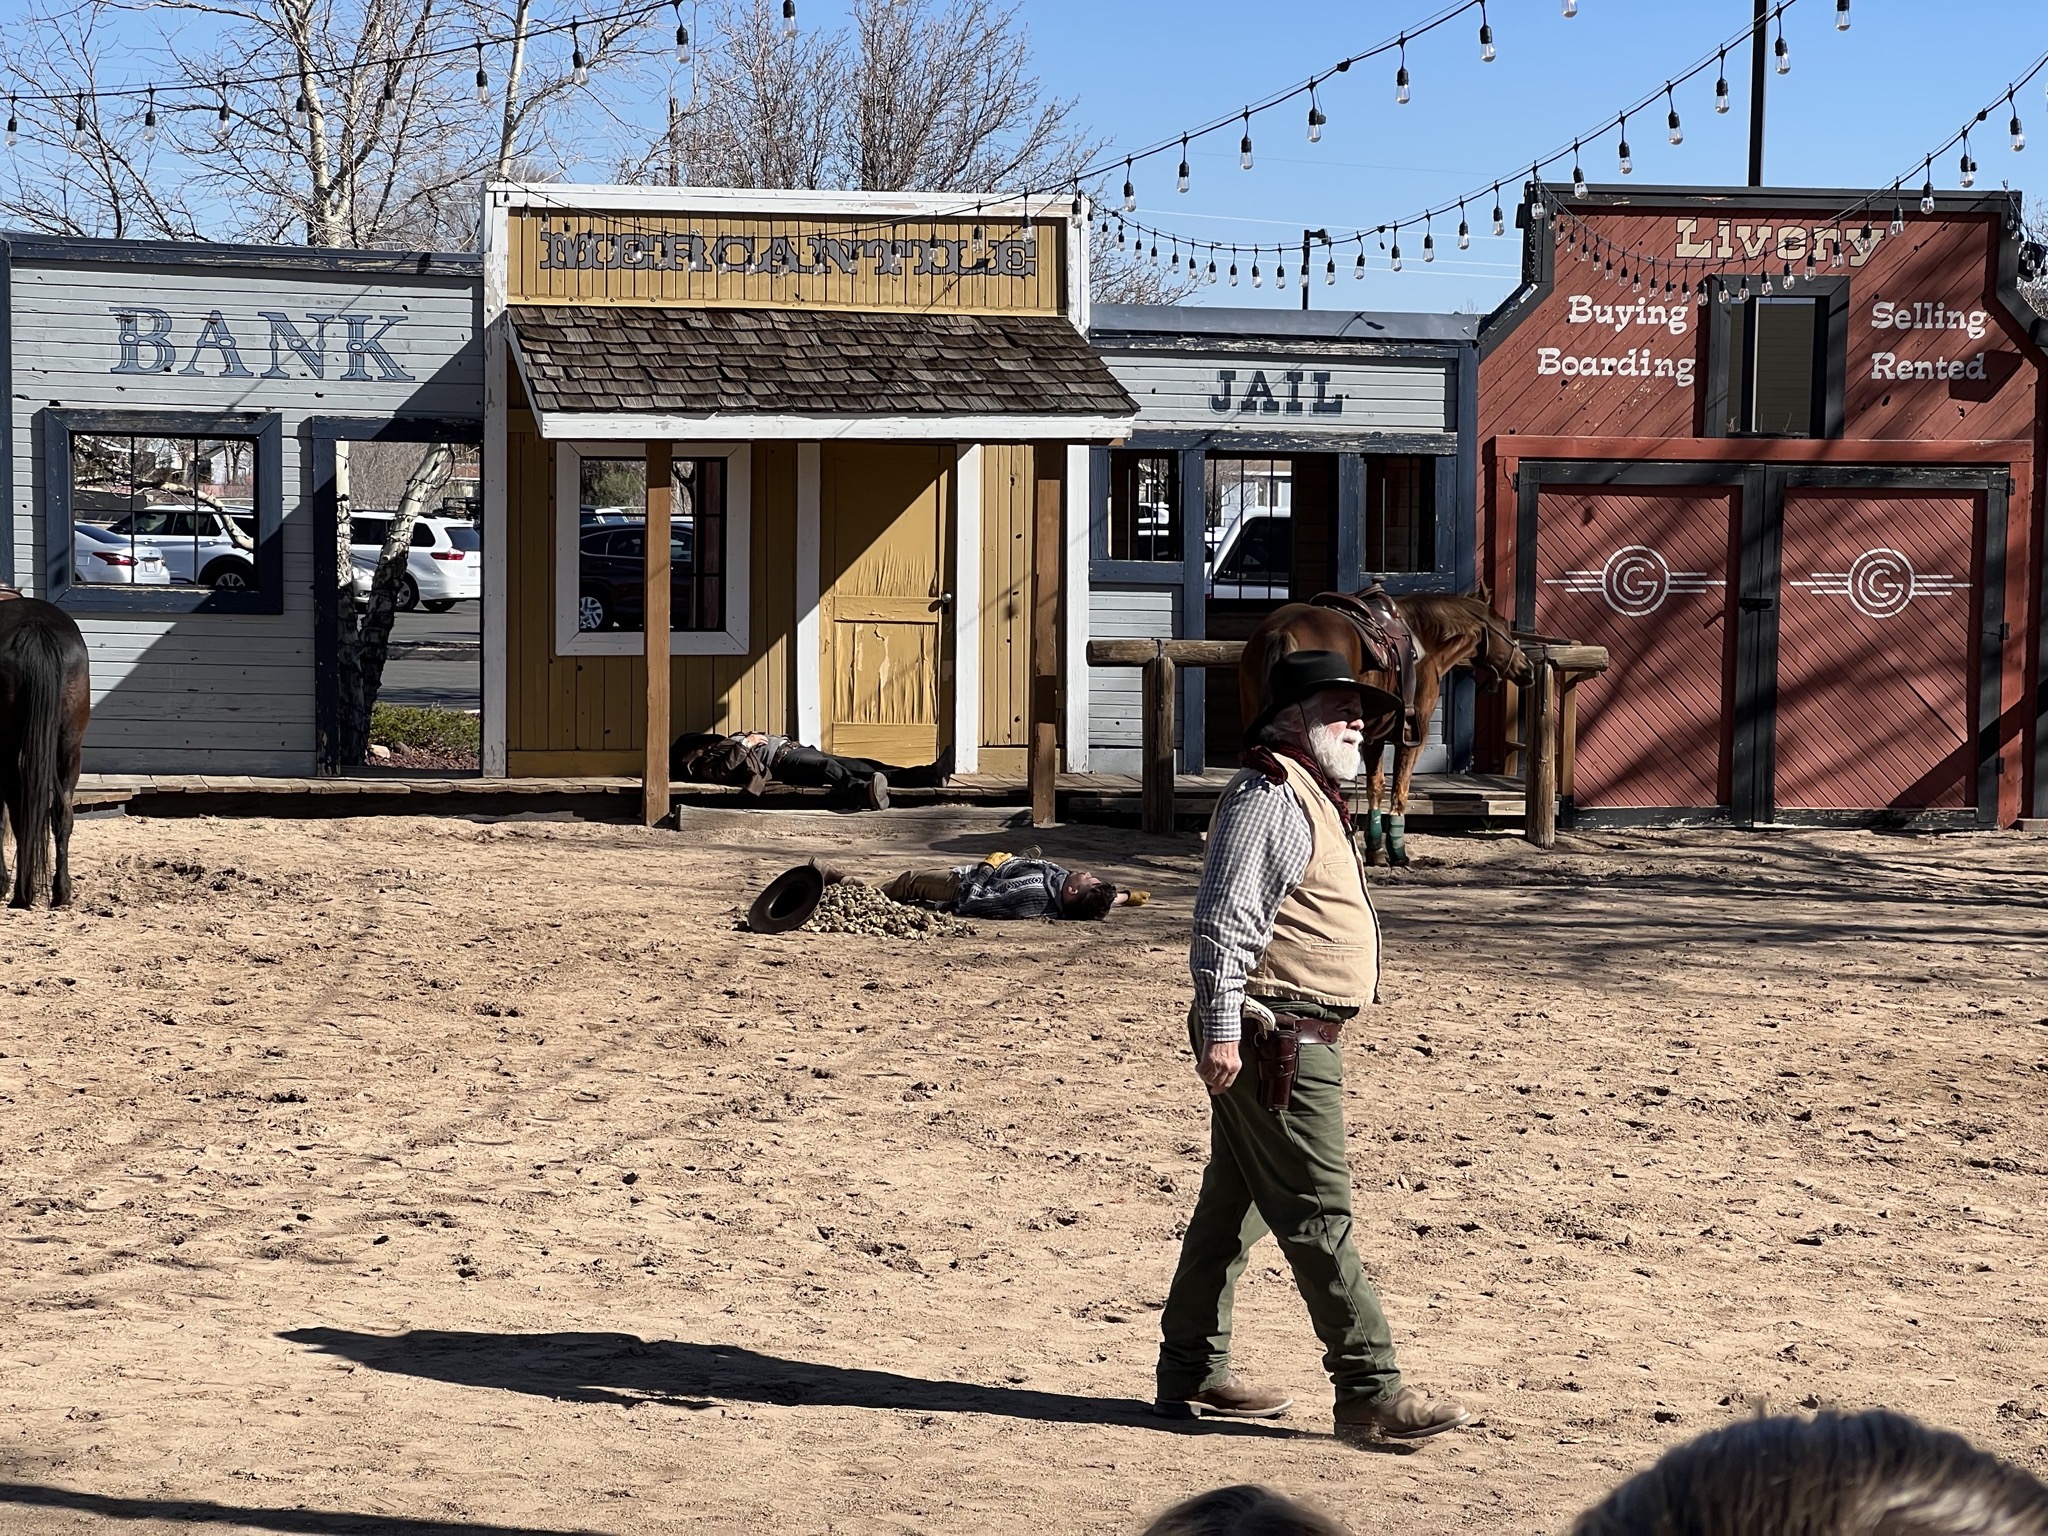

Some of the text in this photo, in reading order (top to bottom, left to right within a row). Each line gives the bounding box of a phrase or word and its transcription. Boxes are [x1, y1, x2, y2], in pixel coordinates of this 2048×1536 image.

[540, 232, 1037, 277] MERCANTILE
[1675, 218, 1886, 267] Livery
[1567, 294, 1689, 336] Buying
[1871, 300, 1988, 340] Selling
[108, 306, 417, 382] BANK
[1537, 347, 1697, 388] Boarding
[1871, 351, 1988, 381] Rented
[1208, 369, 1344, 418] JAIL
